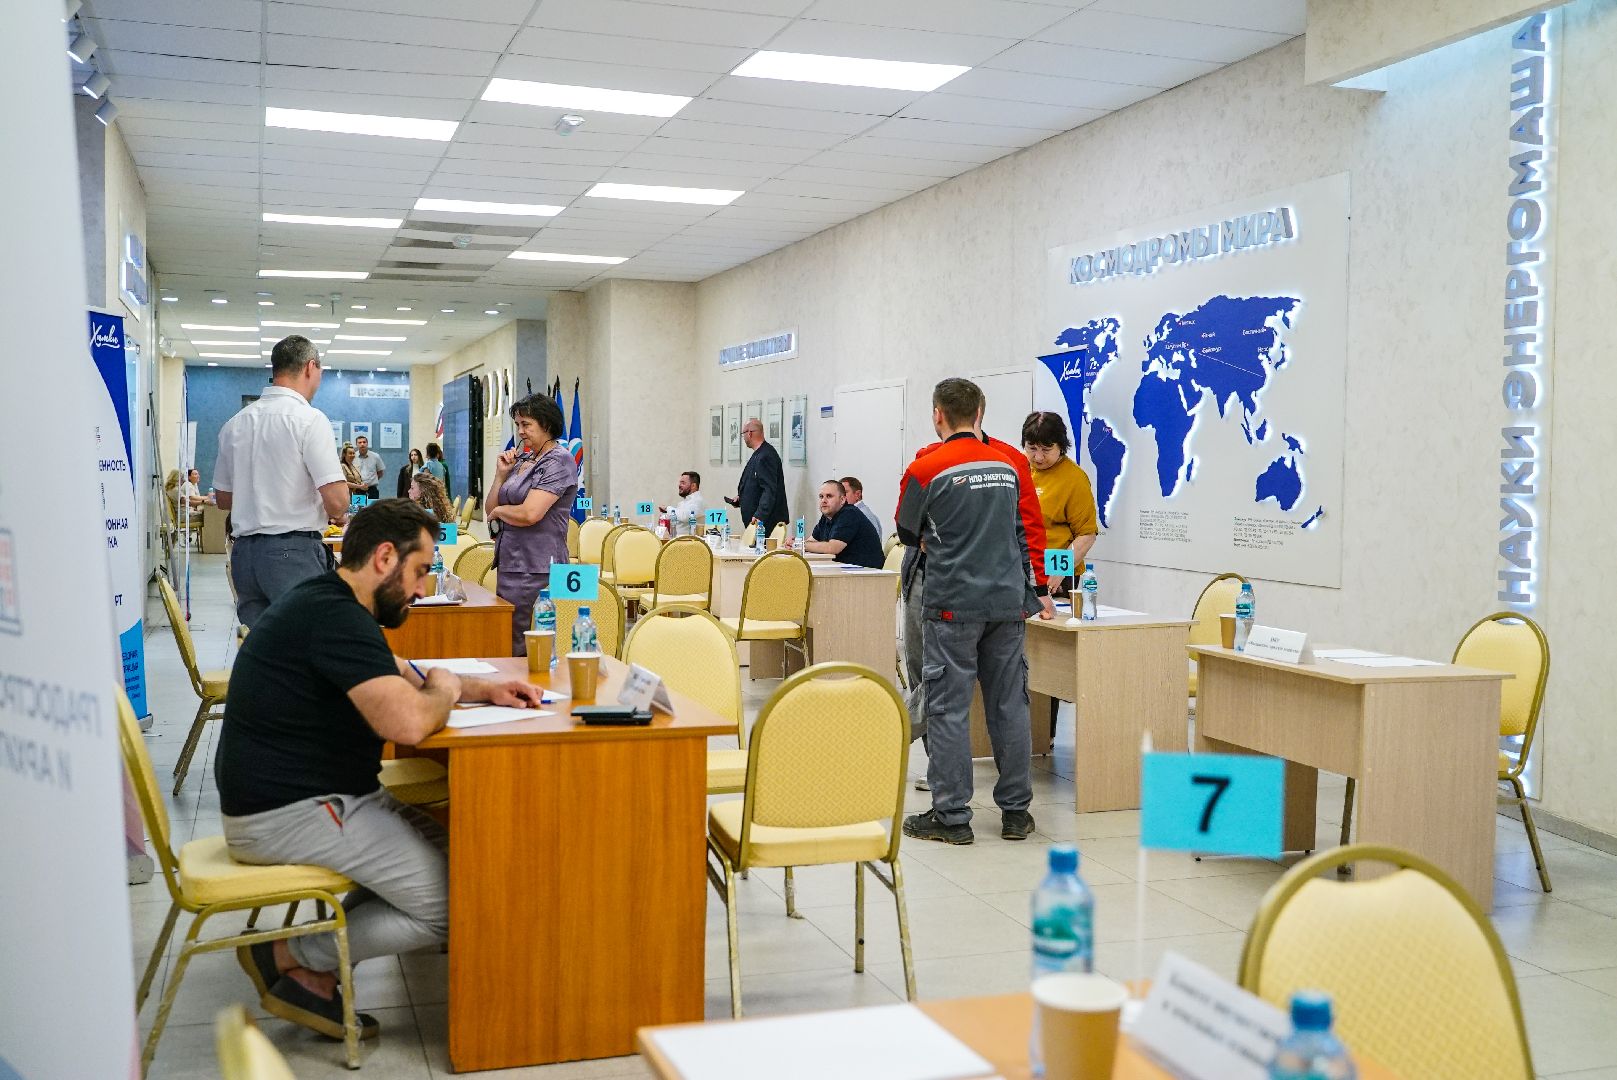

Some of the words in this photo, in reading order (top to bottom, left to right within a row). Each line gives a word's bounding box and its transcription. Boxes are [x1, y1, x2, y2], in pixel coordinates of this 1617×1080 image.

[1501, 12, 1547, 409] ЭНЕРГОМАША
[1070, 224, 1219, 284] КОСМОДРОМЫ
[1220, 207, 1294, 252] МИРА
[356, 495, 361, 504] 2
[580, 500, 590, 508] 19
[641, 504, 651, 513] 18
[709, 512, 722, 523] 17
[1497, 427, 1536, 603] НАУКИ
[1051, 554, 1069, 571] 15
[566, 570, 581, 593] 6
[1190, 774, 1231, 834] 7
